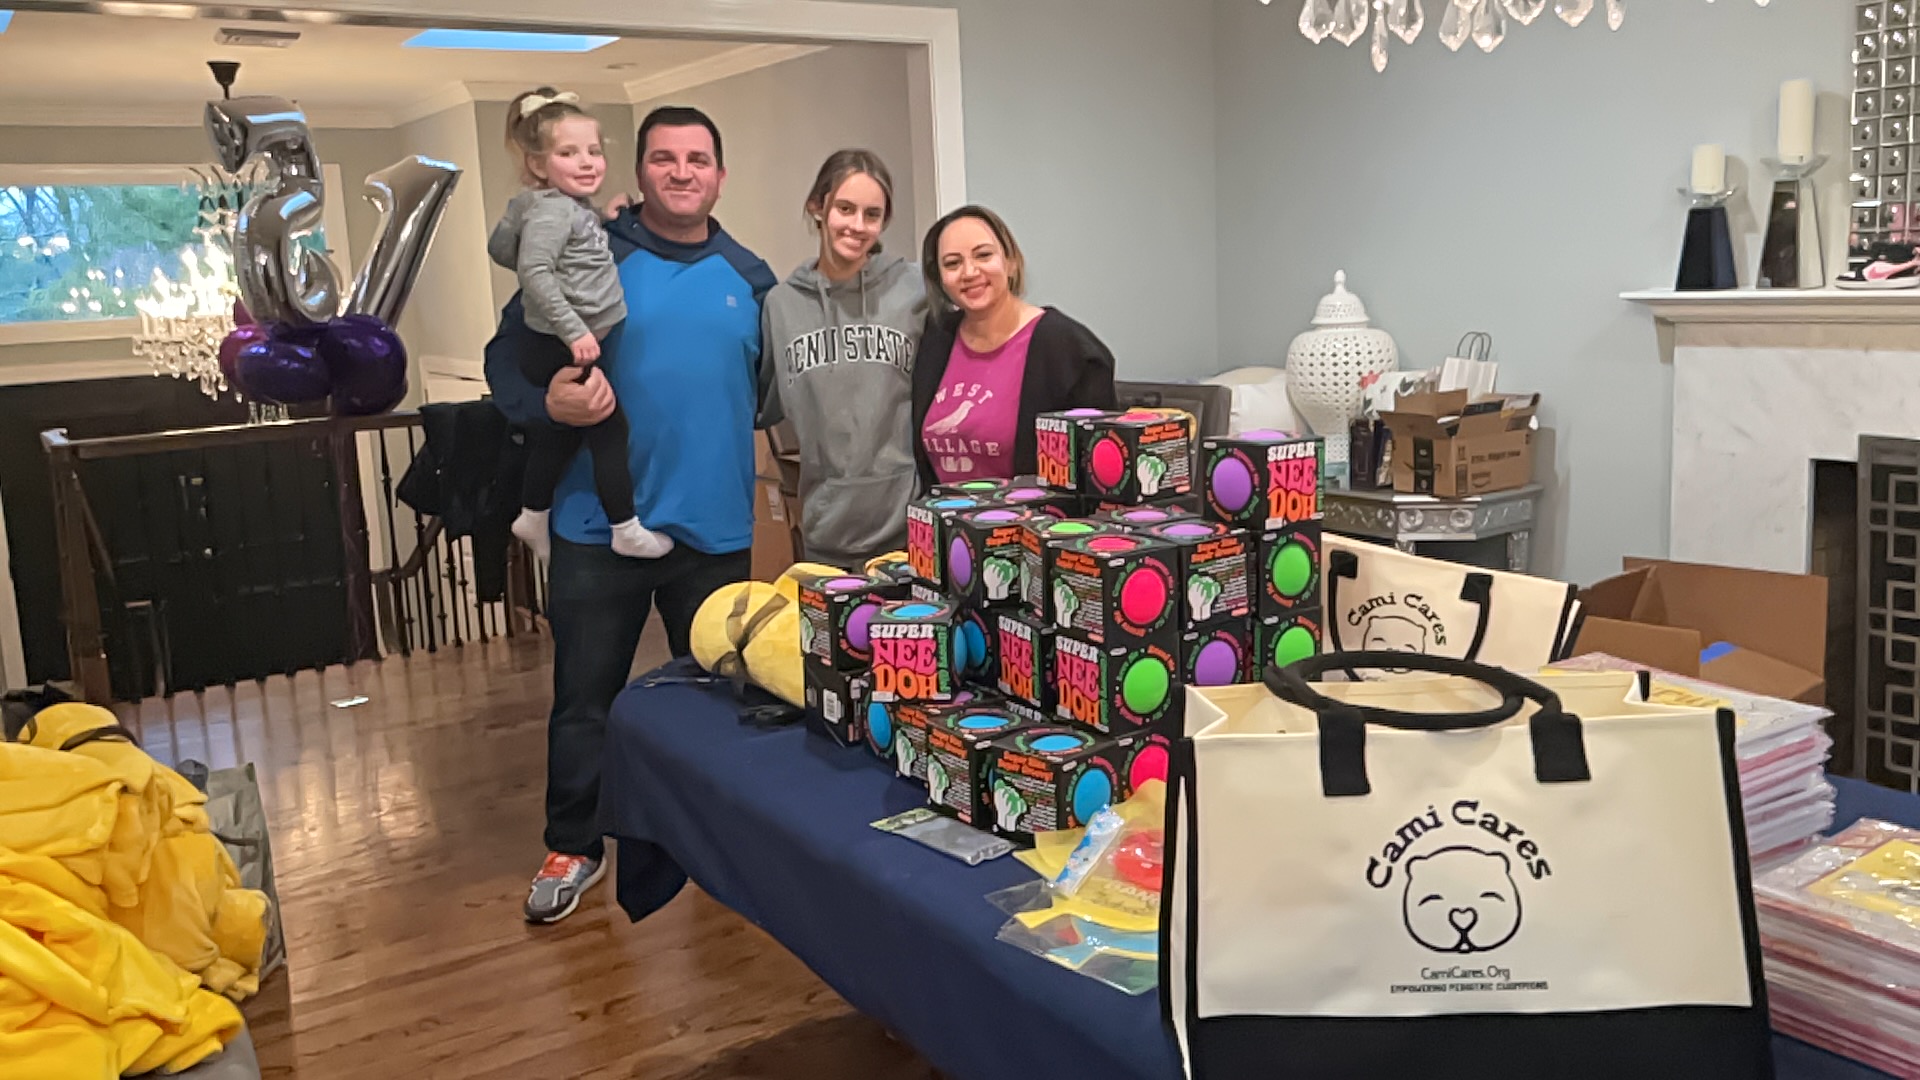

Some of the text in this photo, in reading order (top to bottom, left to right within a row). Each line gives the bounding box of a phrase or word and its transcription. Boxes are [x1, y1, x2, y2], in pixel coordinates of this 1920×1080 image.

[843, 325, 914, 375] STATE
[935, 382, 994, 405] WEST
[923, 438, 1000, 457] ILLAGE
[1037, 430, 1068, 467] NEE
[1266, 442, 1316, 462] SUPER
[1038, 451, 1069, 486] DOH
[1267, 457, 1318, 495] NEE
[1267, 487, 1317, 522] DOH
[909, 541, 934, 580] DOH
[869, 623, 934, 639] SUPER
[998, 615, 1031, 641] SUPER
[1347, 592, 1447, 647] Cami Cares
[870, 638, 937, 676] NEE
[999, 630, 1033, 678] NEE
[1056, 635, 1099, 664] SUPER
[872, 663, 938, 699] DOH
[1001, 655, 1033, 700] DOH
[1057, 650, 1099, 702] NEE
[1059, 677, 1099, 725] DOH
[1365, 800, 1552, 889] Cami Cares
[1420, 965, 1511, 981] CamiCares.Org
